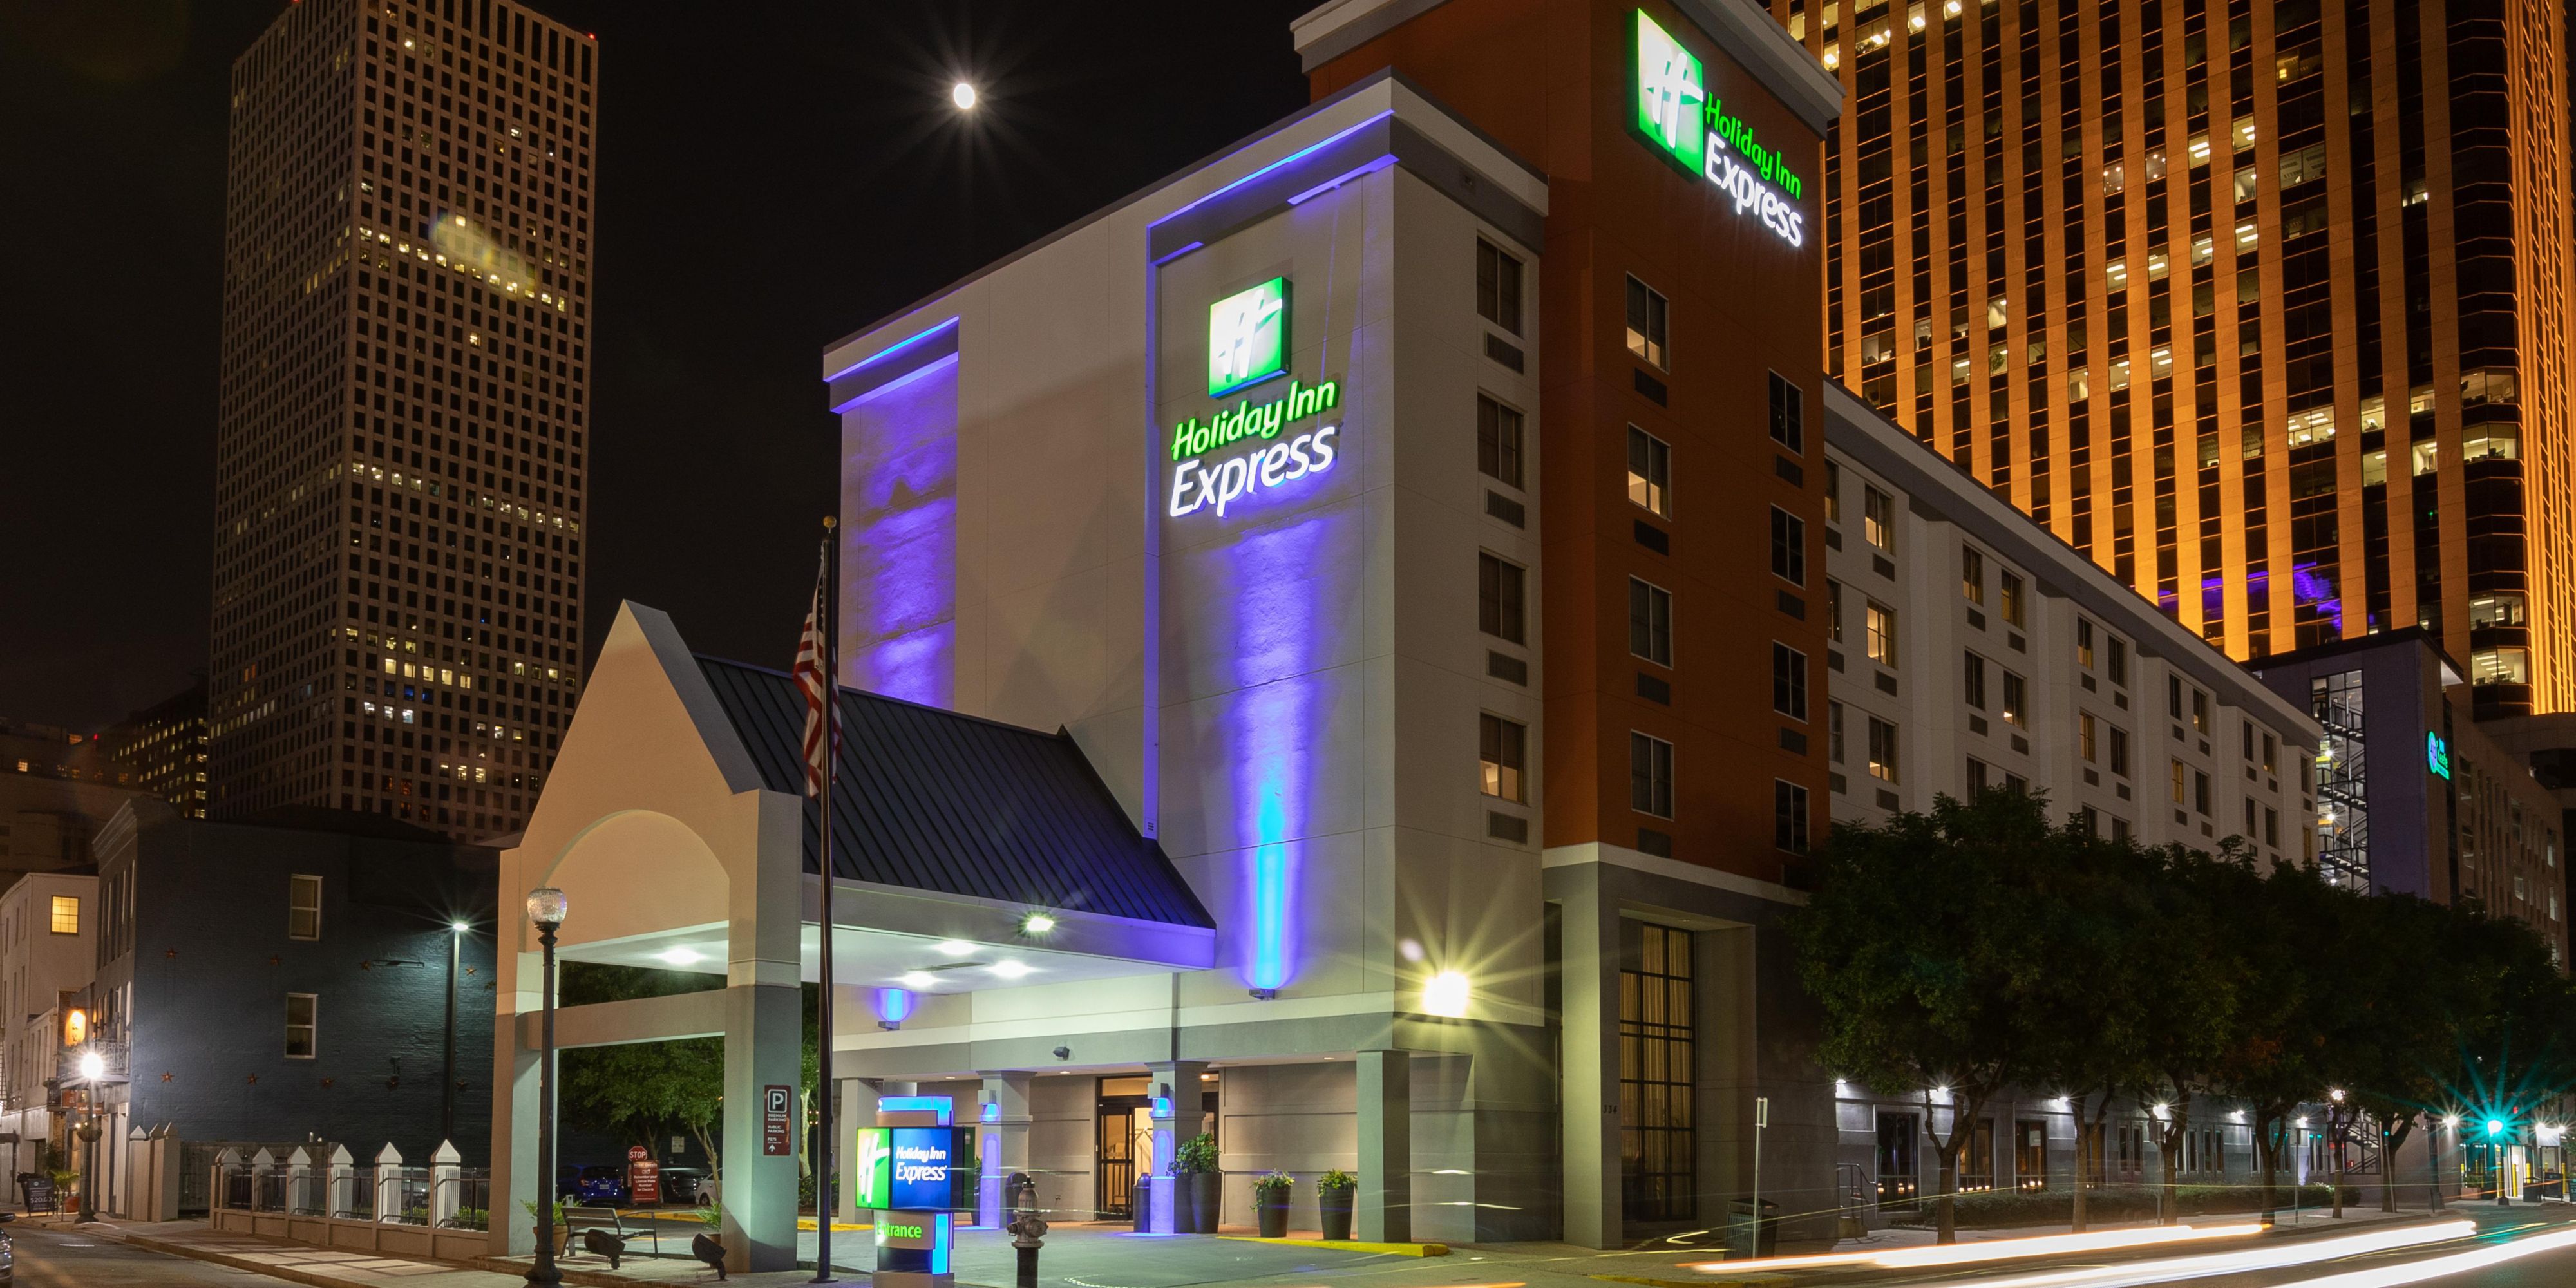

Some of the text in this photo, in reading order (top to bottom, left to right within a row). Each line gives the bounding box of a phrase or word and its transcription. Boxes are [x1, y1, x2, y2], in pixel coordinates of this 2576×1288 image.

[1705, 91, 1801, 200] Holiday Inn
[1705, 132, 1802, 247] Express
[1171, 381, 1336, 462] Holiday Inn
[1170, 426, 1336, 518] Express
[773, 1092, 784, 1110] P
[896, 1146, 947, 1163] Holiday Inn
[896, 1162, 946, 1185] Express
[877, 1221, 922, 1238] Entrance
